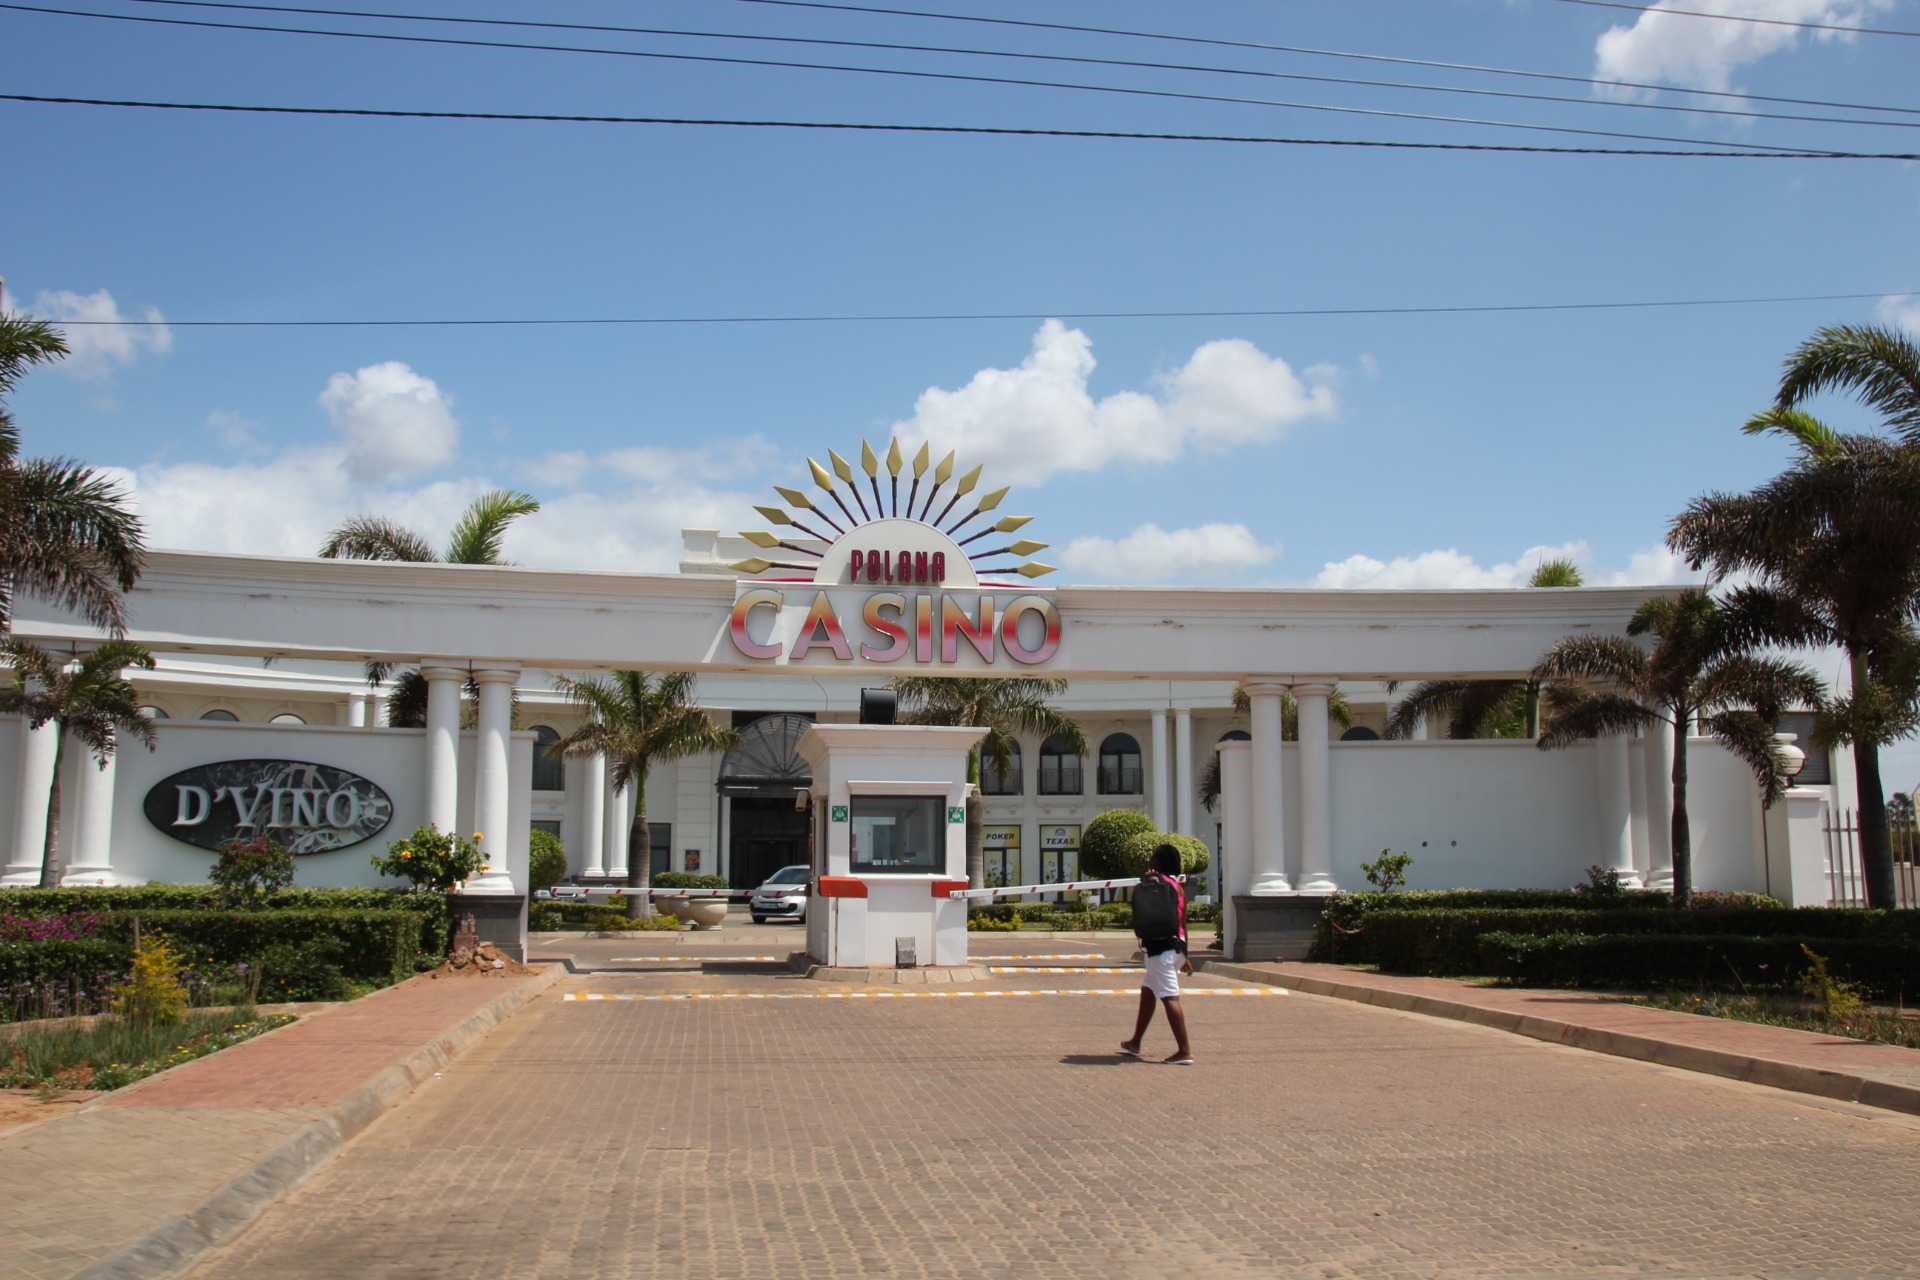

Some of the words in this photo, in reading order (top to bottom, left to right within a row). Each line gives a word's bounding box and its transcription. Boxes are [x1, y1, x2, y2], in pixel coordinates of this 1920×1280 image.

[851, 549, 946, 582] POLANA
[730, 588, 1063, 665] CASINO
[171, 780, 361, 828] D'VINO
